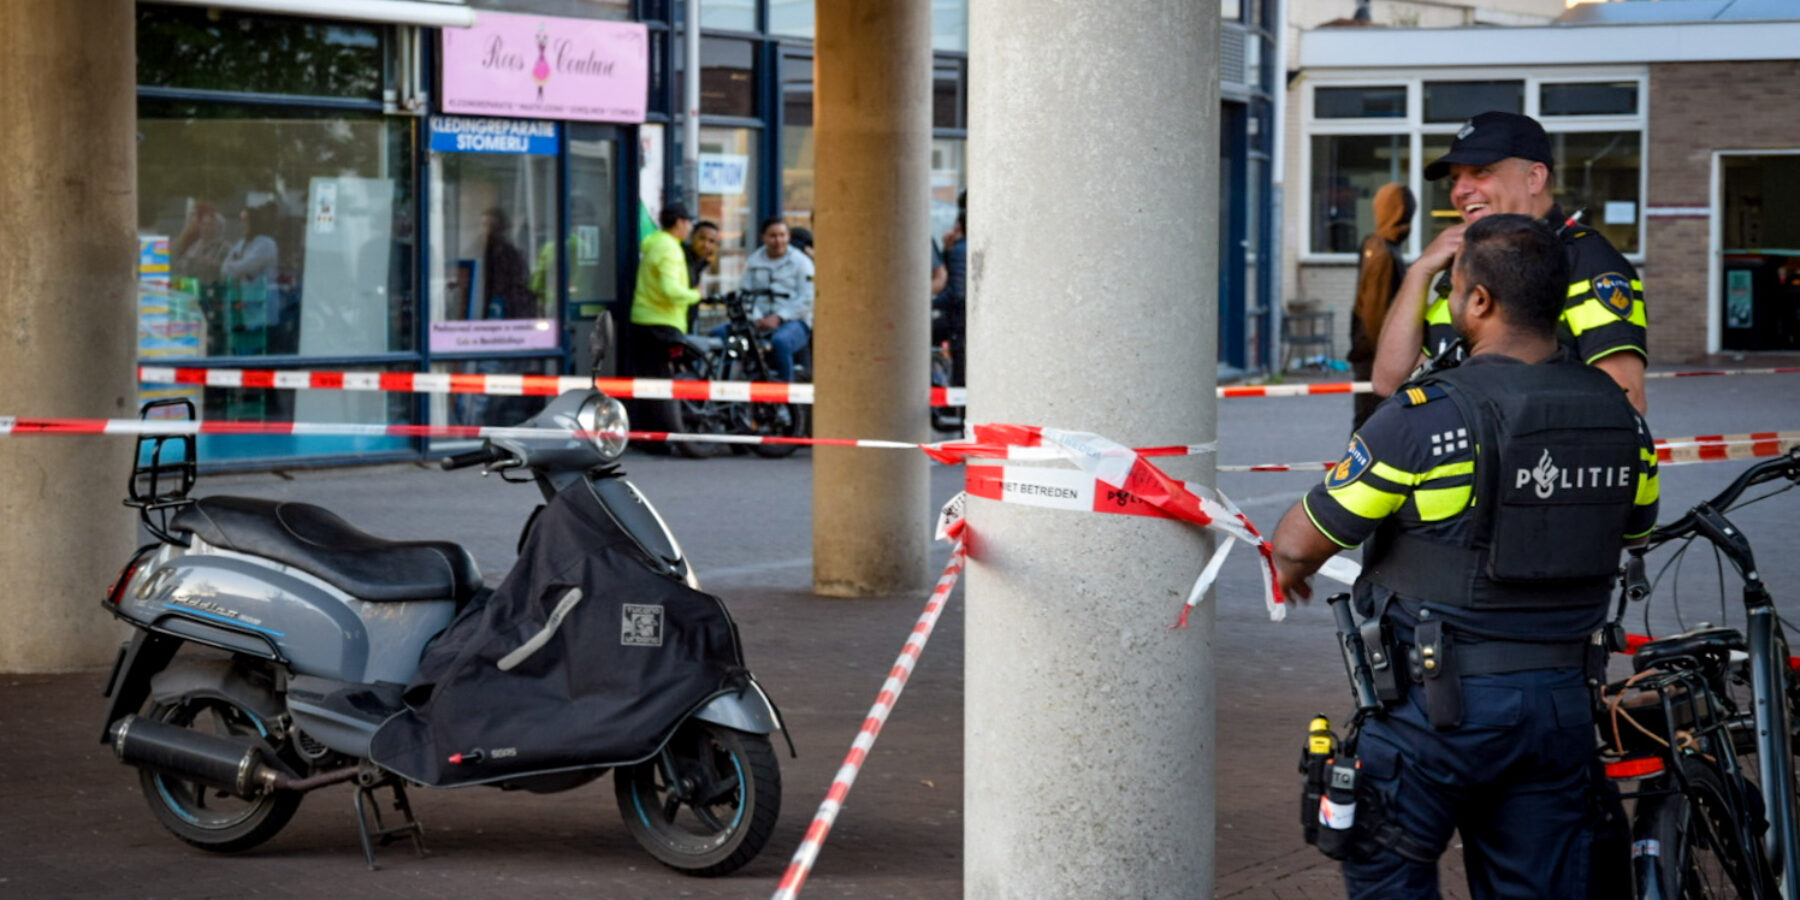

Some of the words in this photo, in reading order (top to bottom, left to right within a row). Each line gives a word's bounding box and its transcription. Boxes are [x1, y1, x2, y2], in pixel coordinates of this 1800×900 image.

[430, 117, 555, 138] KLEDINGREPARATIE
[456, 135, 529, 152] STOMERIJ
[1515, 448, 1630, 499] POLITIE
[1020, 483, 1078, 499] BETREDEN
[1333, 772, 1351, 785] TQ
